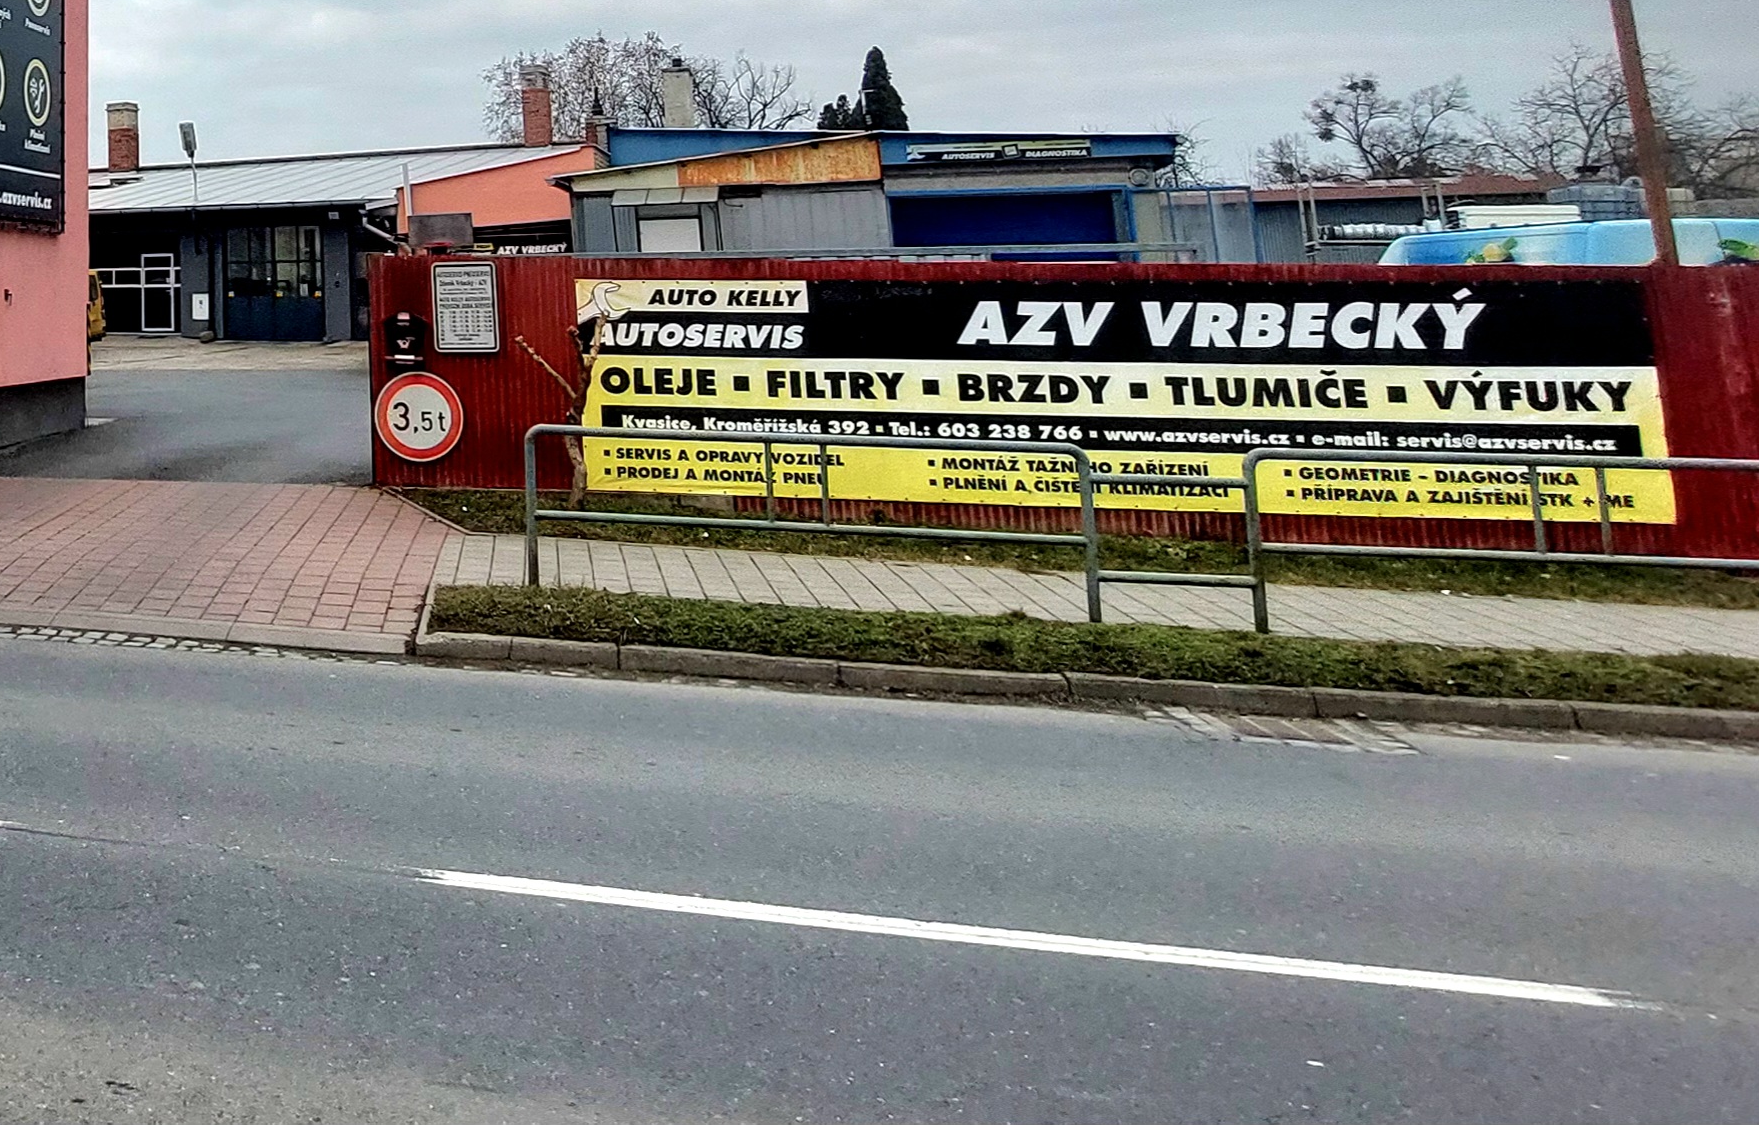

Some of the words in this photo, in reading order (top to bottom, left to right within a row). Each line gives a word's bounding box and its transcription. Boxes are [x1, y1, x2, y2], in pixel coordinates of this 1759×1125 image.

[1025, 149, 1087, 158] DIAGNOSTIKA
[497, 246, 519, 255] AZV
[521, 242, 567, 254] VRBECKÝ
[649, 289, 717, 306] AUTO
[727, 290, 802, 307] KELLY
[957, 301, 1115, 346] AZV
[1141, 287, 1486, 350] VRBECKÝ
[589, 323, 805, 349] AUTOSERVIS
[600, 367, 717, 396] OLEJE
[767, 370, 905, 400] FILTRY
[957, 374, 1111, 404] BRZDY
[1164, 370, 1368, 408] TLUMIČE
[1424, 371, 1632, 412] VÝFUKY
[622, 415, 697, 430] Kvasice,
[703, 417, 822, 434] Kroměřížská
[828, 420, 871, 434] 392
[888, 421, 931, 436] Tel.:
[937, 423, 980, 437] 603
[988, 424, 1031, 439] 238
[1040, 426, 1083, 440] 766
[1103, 428, 1290, 445] www.azvservis.cz
[1312, 431, 1389, 448] e-mail:
[1396, 433, 1617, 451] servis@azvservis.cz
[616, 448, 672, 460] SERVIS
[677, 450, 690, 461] A
[695, 450, 763, 463] OPRAVY
[617, 466, 679, 479] PRODEJ
[685, 469, 698, 480] A
[941, 455, 1020, 471] MONTÁŽ
[1119, 460, 1209, 476] ZAŘÍZENÍ
[1299, 467, 1411, 482] GEOMETRIE
[943, 474, 1007, 491] PLNĚNÍ
[1014, 479, 1028, 491] A
[1301, 484, 1398, 503] PŘÍPRAVA
[1405, 490, 1420, 503] A
[1427, 488, 1528, 505] ZAJIŠTĚNÍ
[1539, 493, 1574, 507] STK
